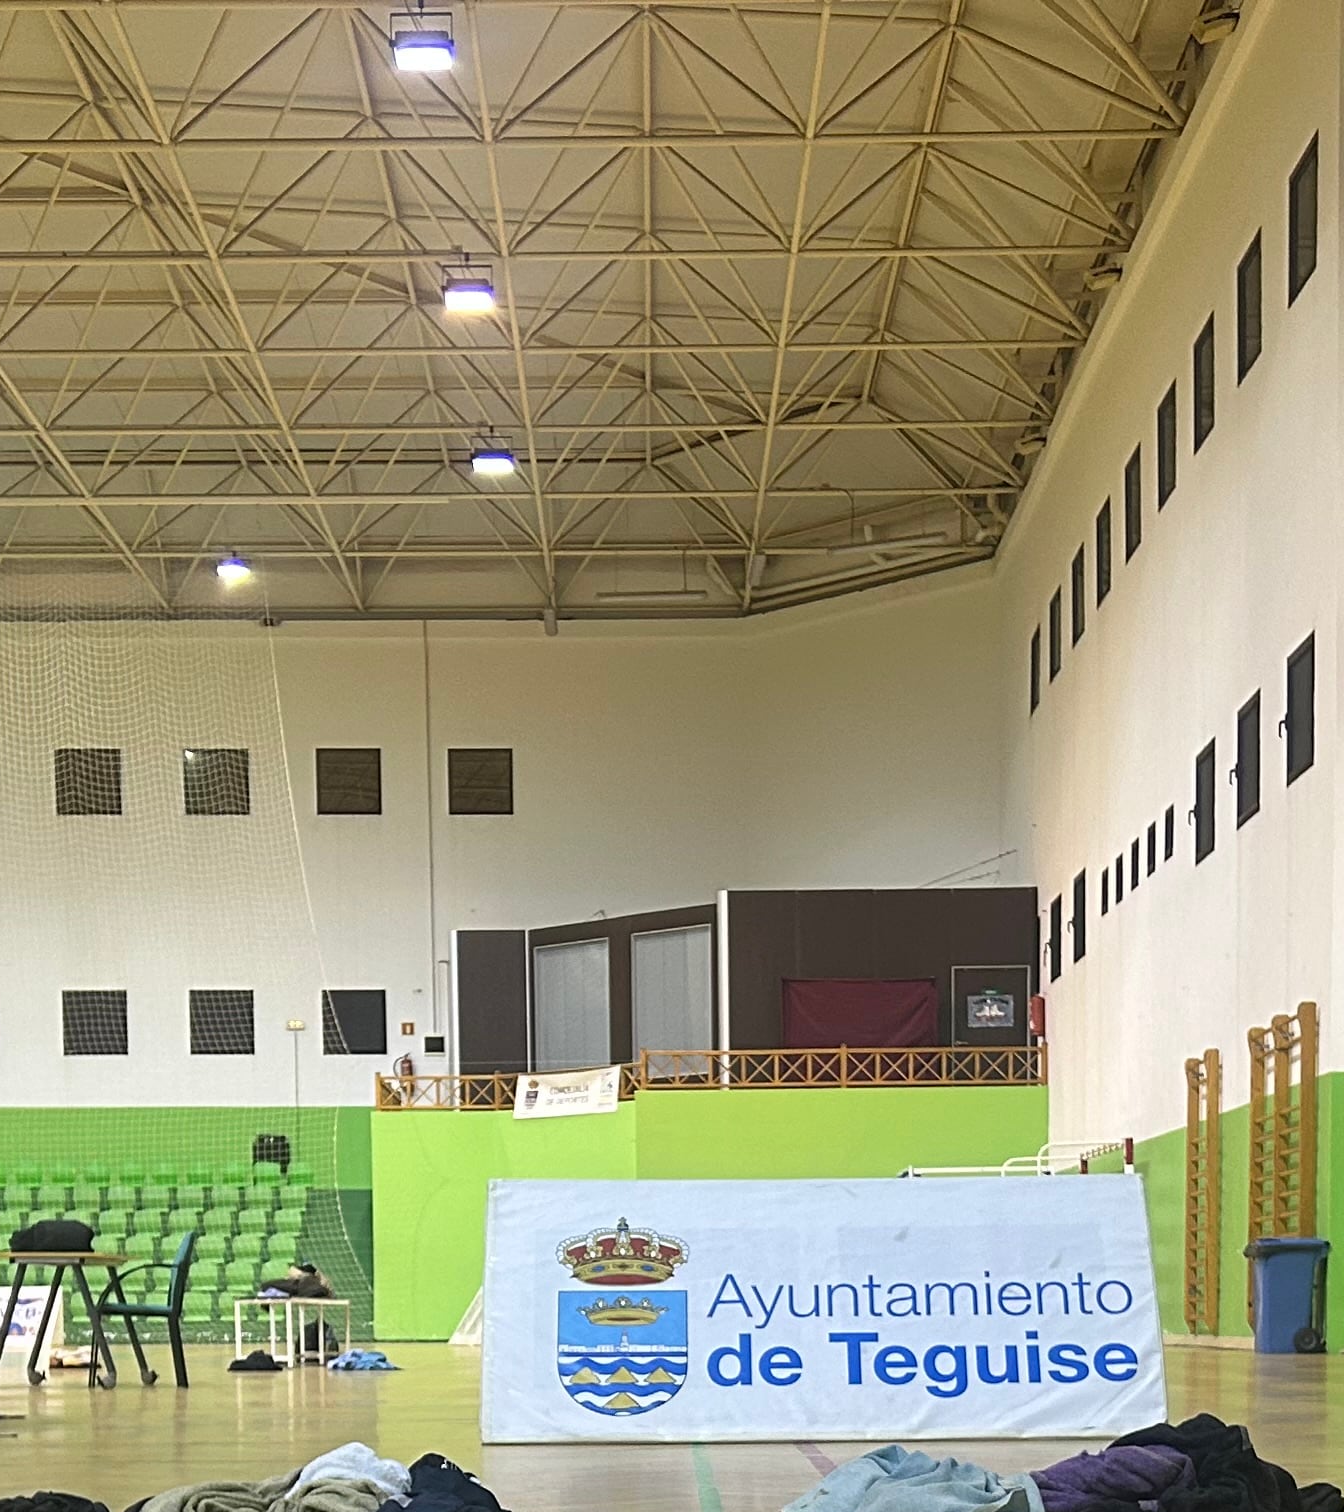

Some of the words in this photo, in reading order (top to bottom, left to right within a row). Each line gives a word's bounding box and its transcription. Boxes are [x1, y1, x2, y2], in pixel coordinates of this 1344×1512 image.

[706, 1270, 1133, 1329] Ayuntamiento
[706, 1333, 803, 1387] de
[829, 1330, 1140, 1398] Teguise
